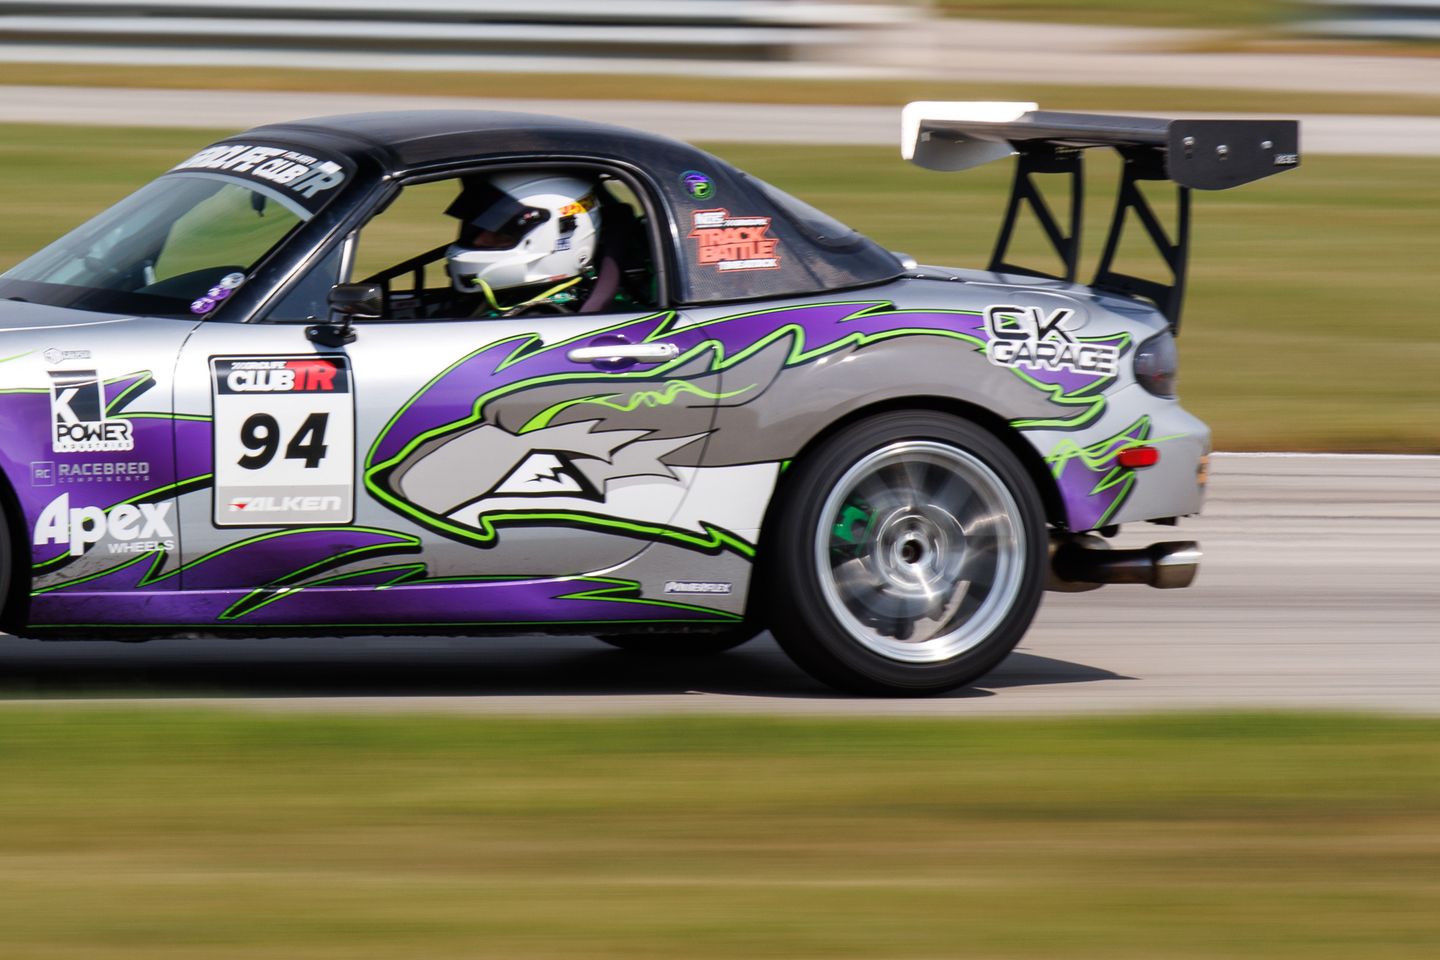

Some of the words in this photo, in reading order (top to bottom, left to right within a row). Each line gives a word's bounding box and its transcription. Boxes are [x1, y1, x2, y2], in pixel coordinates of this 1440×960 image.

[699, 240, 775, 262] BATTLE
[992, 340, 1115, 374] GARAGE
[57, 423, 129, 442] POWER
[237, 413, 329, 469] 94
[59, 462, 150, 476] RACEBRED
[227, 495, 341, 512] FALKEN
[34, 492, 174, 556] Apex
[108, 540, 175, 554] WHEELS
